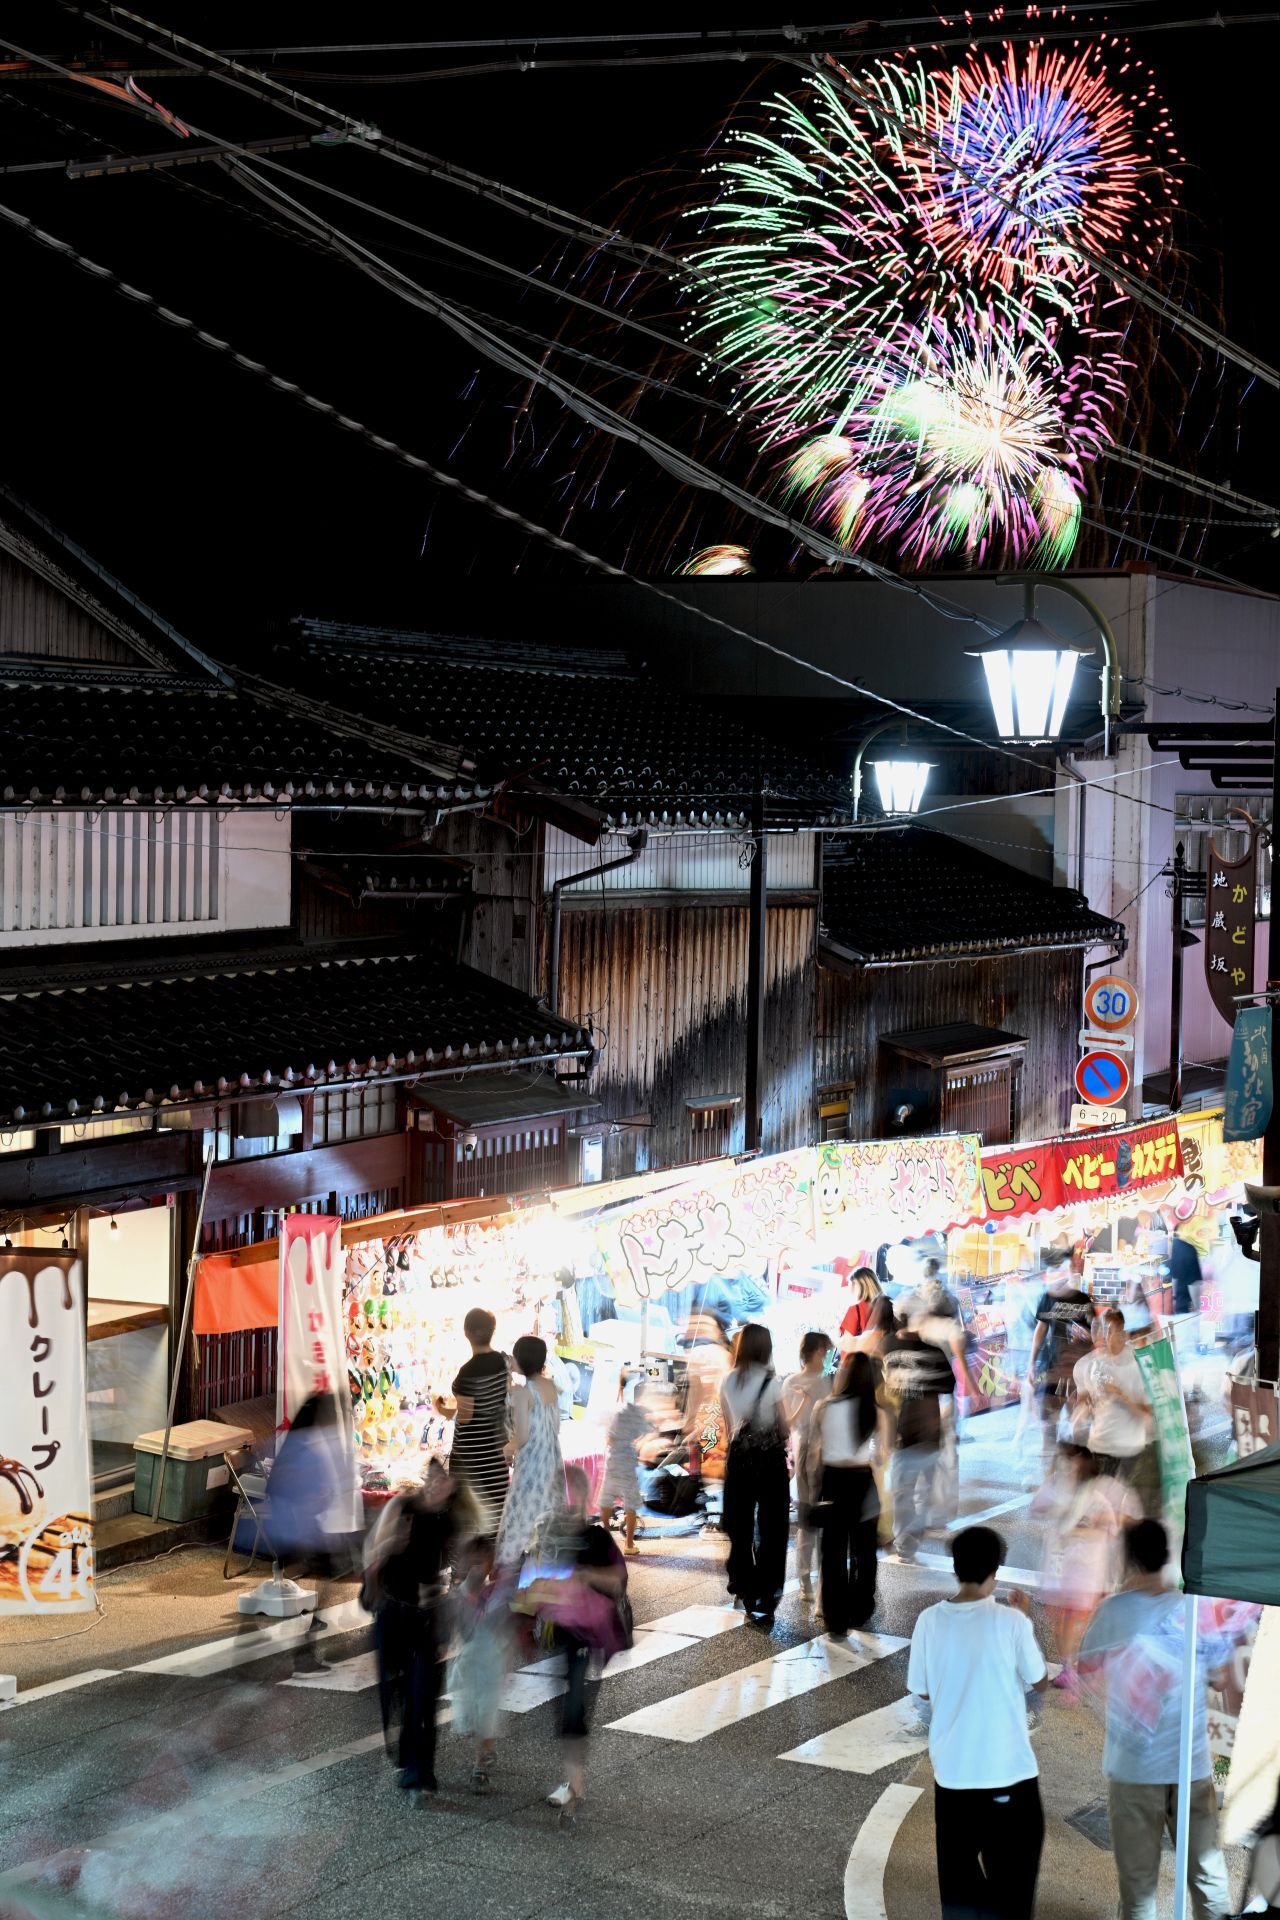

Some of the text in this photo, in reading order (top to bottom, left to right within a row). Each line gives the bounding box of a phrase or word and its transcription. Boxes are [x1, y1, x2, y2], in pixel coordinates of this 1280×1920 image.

[1210, 871, 1229, 973] 地蔵坂
[1230, 884, 1248, 986] かどや
[1096, 991, 1126, 1016] 30
[1063, 1152, 1116, 1190] ベビー
[1131, 1132, 1177, 1179] カステラ
[29, 1334, 61, 1471] クレープ
